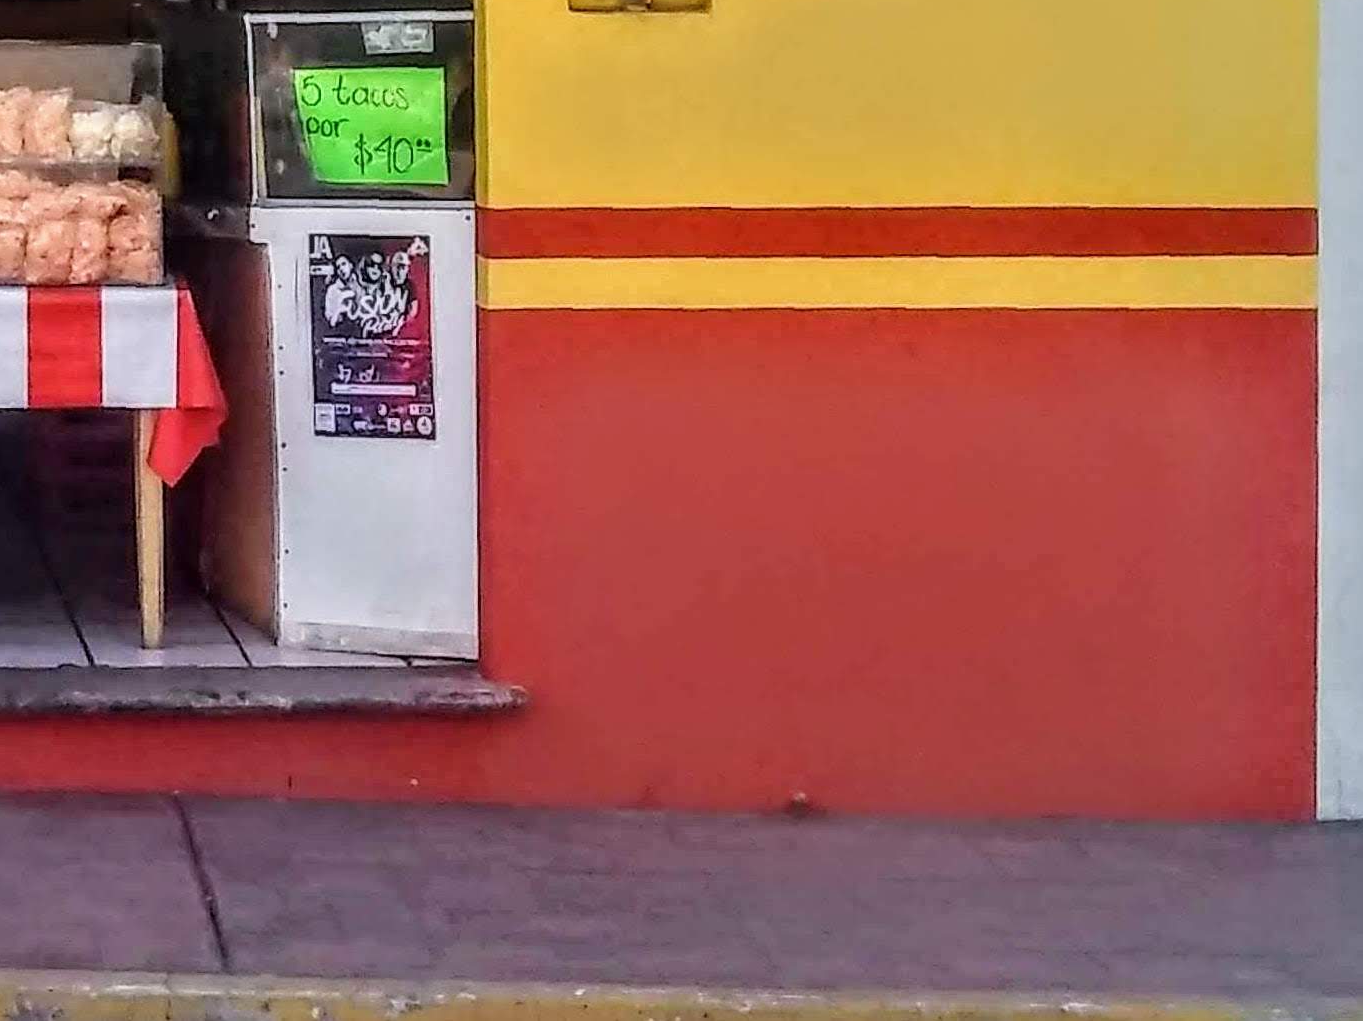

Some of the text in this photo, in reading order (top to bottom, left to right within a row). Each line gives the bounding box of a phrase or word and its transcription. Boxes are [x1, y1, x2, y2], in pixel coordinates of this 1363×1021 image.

[301, 75, 409, 110] 5 tacos
[306, 116, 350, 138] por
